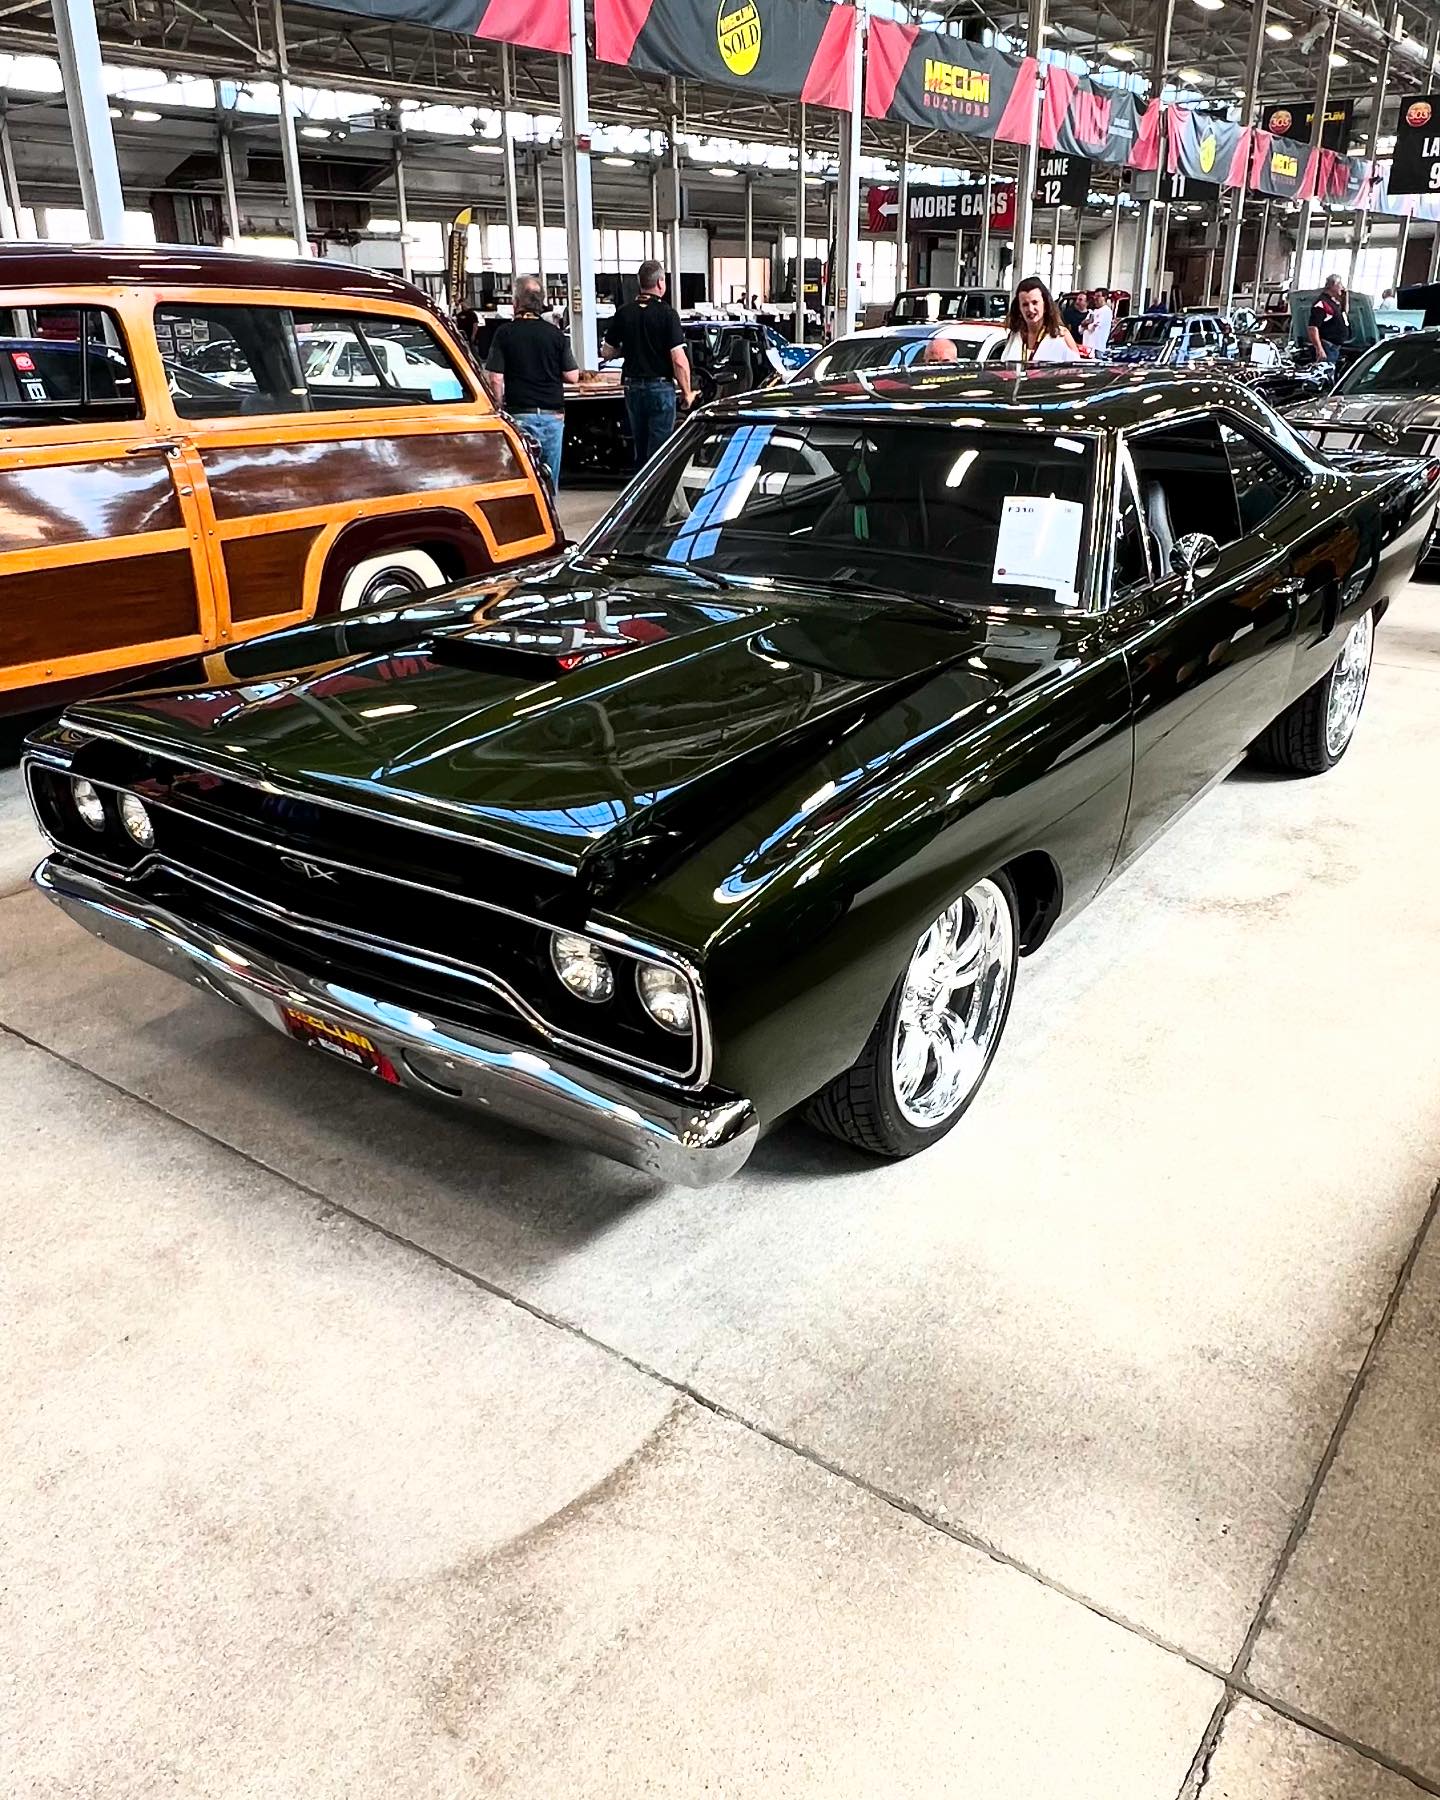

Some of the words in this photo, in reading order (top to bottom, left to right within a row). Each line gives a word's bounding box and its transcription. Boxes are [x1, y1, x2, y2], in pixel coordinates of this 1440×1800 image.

[723, 24, 759, 59] SOLD
[924, 58, 991, 104] MECUM
[923, 93, 990, 118] AUCTIONS
[1041, 157, 1069, 177] LANE
[1428, 162, 1440, 189] 9
[1044, 181, 1061, 204] 12
[1171, 174, 1185, 198] 11
[910, 195, 956, 219] MORE
[961, 192, 1008, 216] CARS
[280, 856, 340, 885] GTX
